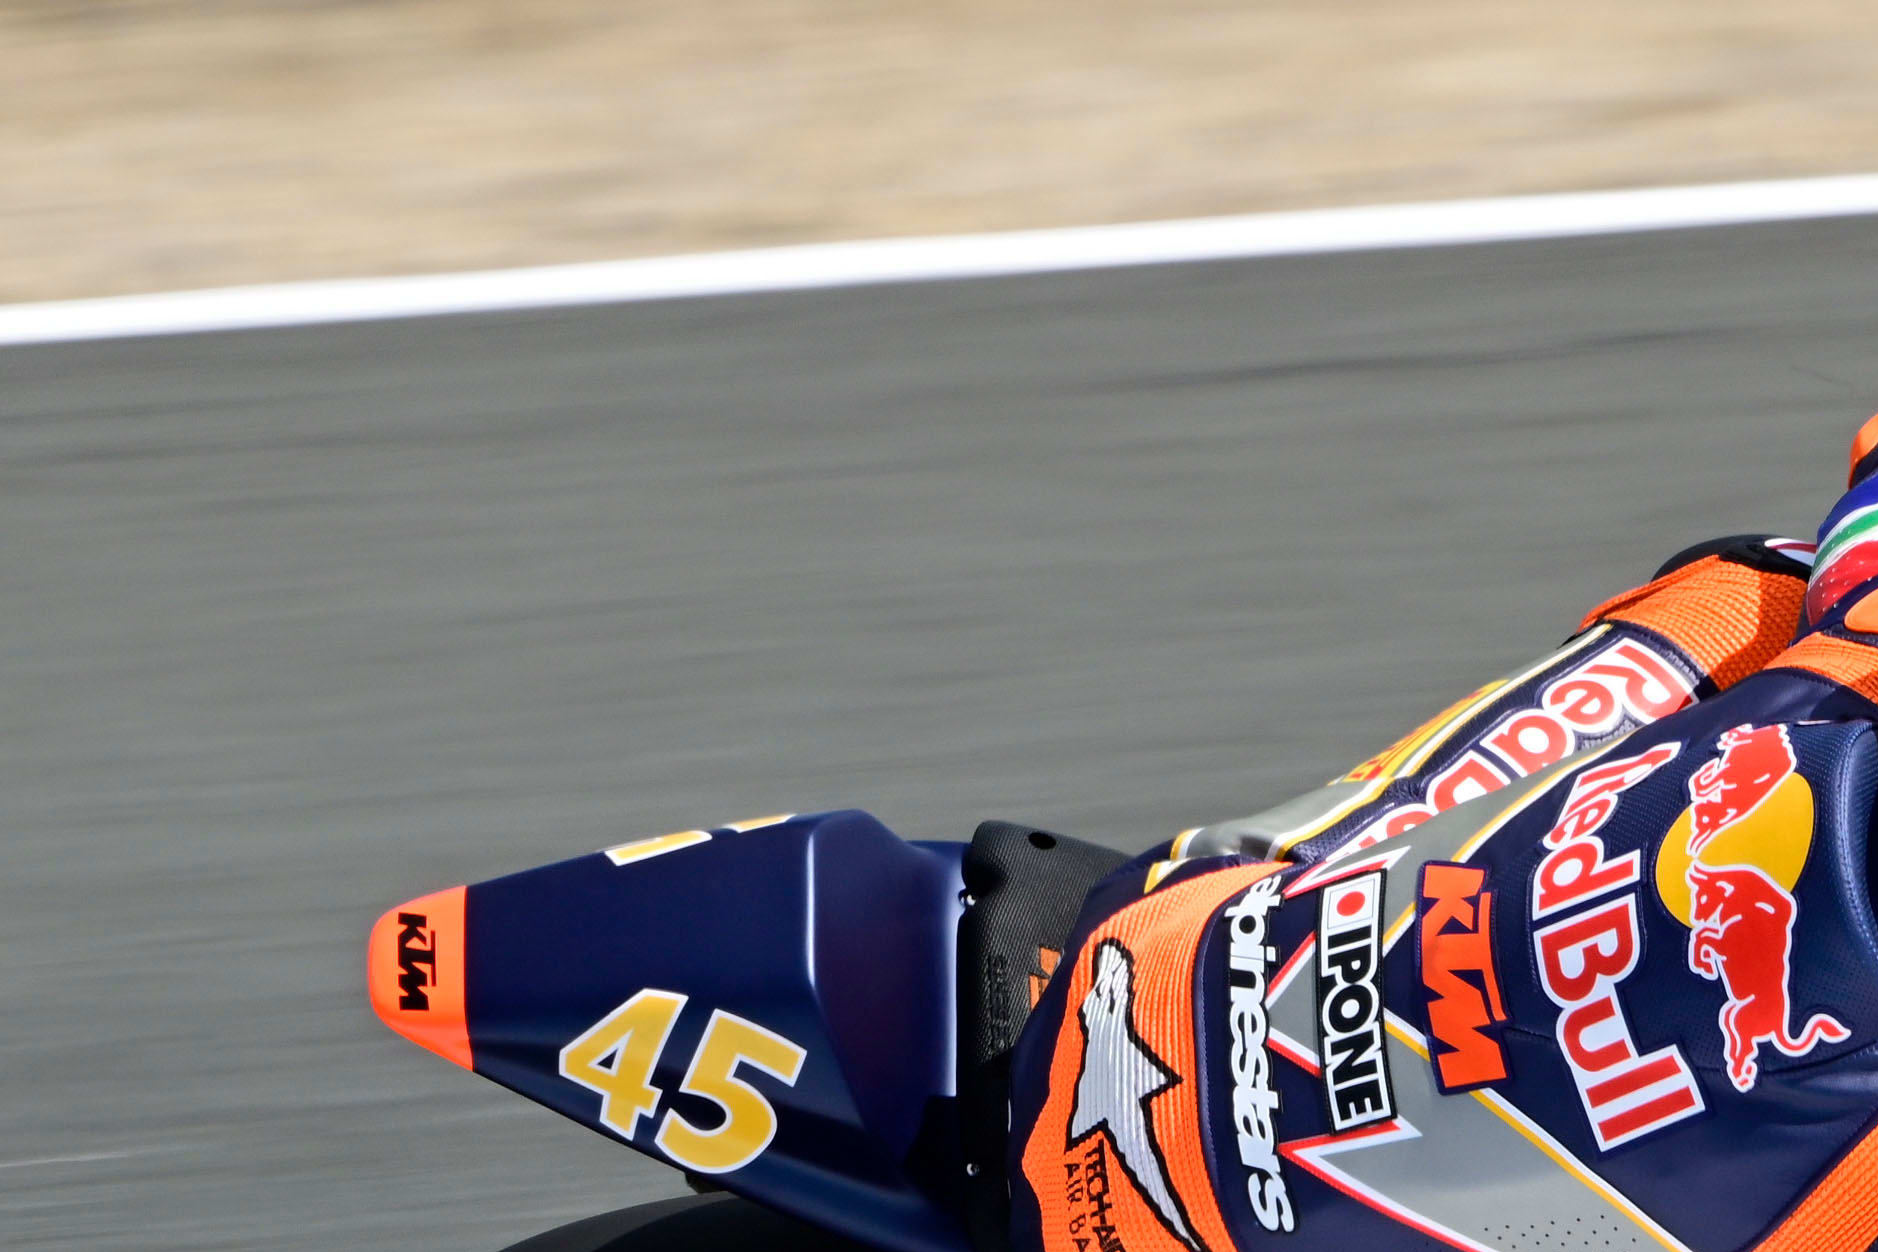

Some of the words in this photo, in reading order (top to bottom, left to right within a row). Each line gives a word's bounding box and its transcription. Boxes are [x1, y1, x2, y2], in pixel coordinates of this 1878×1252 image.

[1532, 742, 1682, 920] Red
[398, 911, 437, 1011] KTM
[1224, 874, 1296, 1233] alpinestars
[1322, 926, 1392, 1123] IPONE
[1421, 863, 1507, 1088] KTM
[1534, 892, 1706, 1151] Bull
[559, 988, 808, 1175] 45
